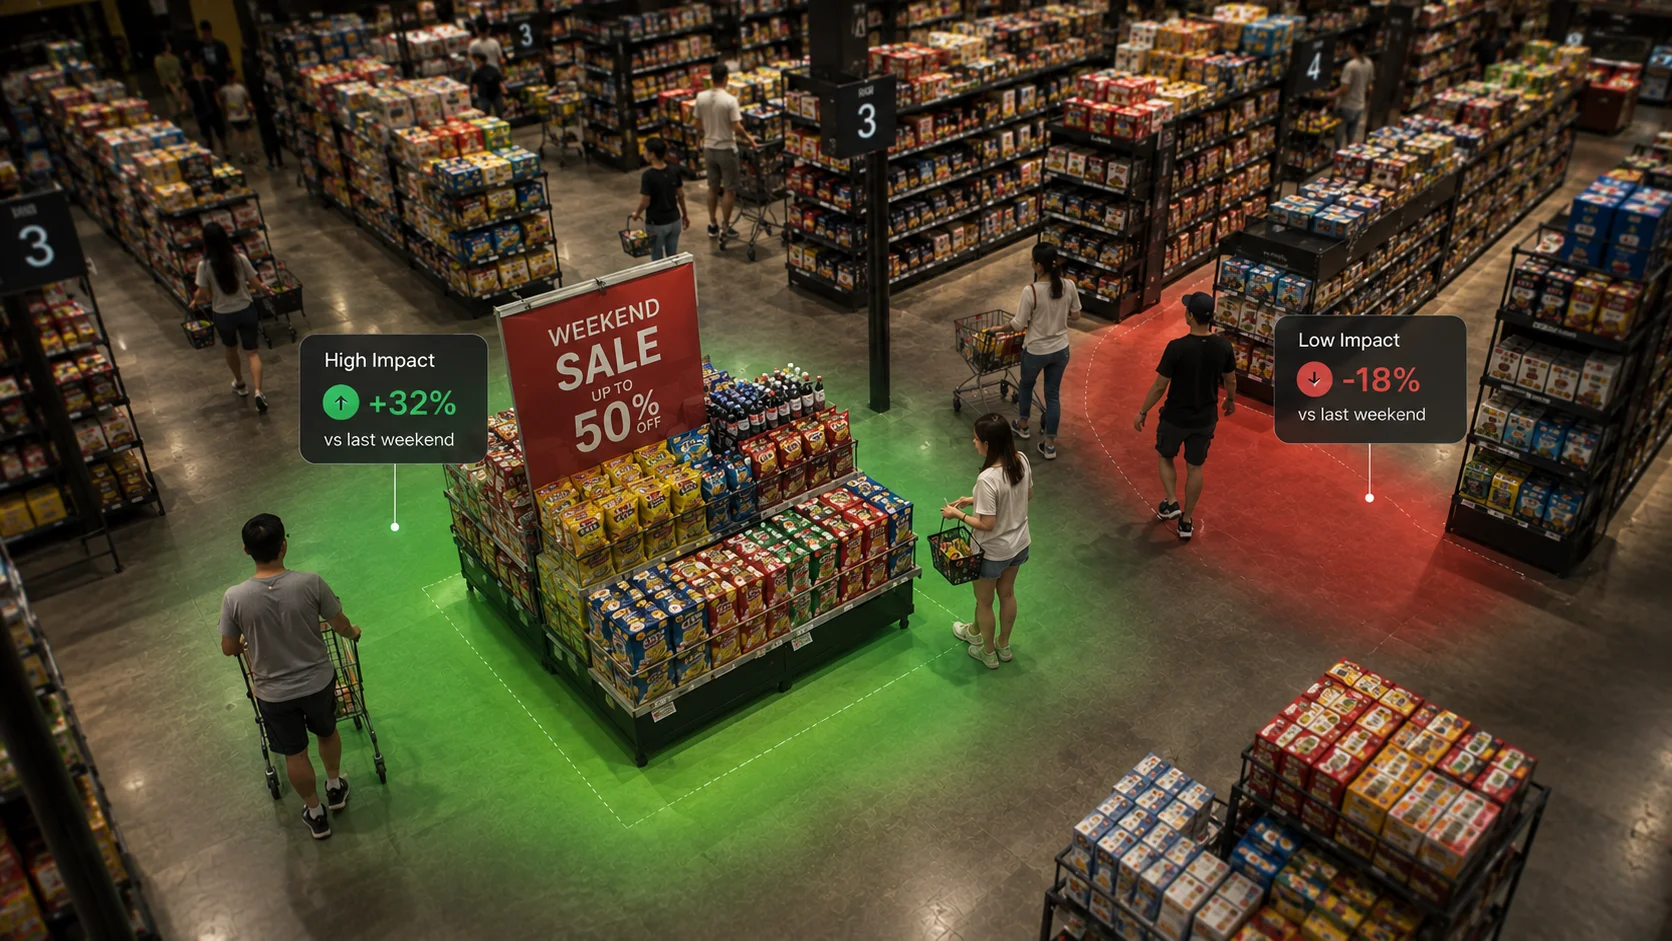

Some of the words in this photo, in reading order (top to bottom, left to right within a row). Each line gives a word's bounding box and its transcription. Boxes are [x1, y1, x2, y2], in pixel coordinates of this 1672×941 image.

[519, 23, 533, 47] 3
[1306, 51, 1321, 81] 4
[857, 103, 877, 139] 3
[18, 224, 55, 268] 3
[547, 298, 661, 347] WEEKEND
[556, 325, 662, 391] SALE
[591, 386, 611, 402] UP
[613, 379, 634, 394] TO
[574, 388, 661, 453] 50%
[636, 415, 661, 434] OFF
